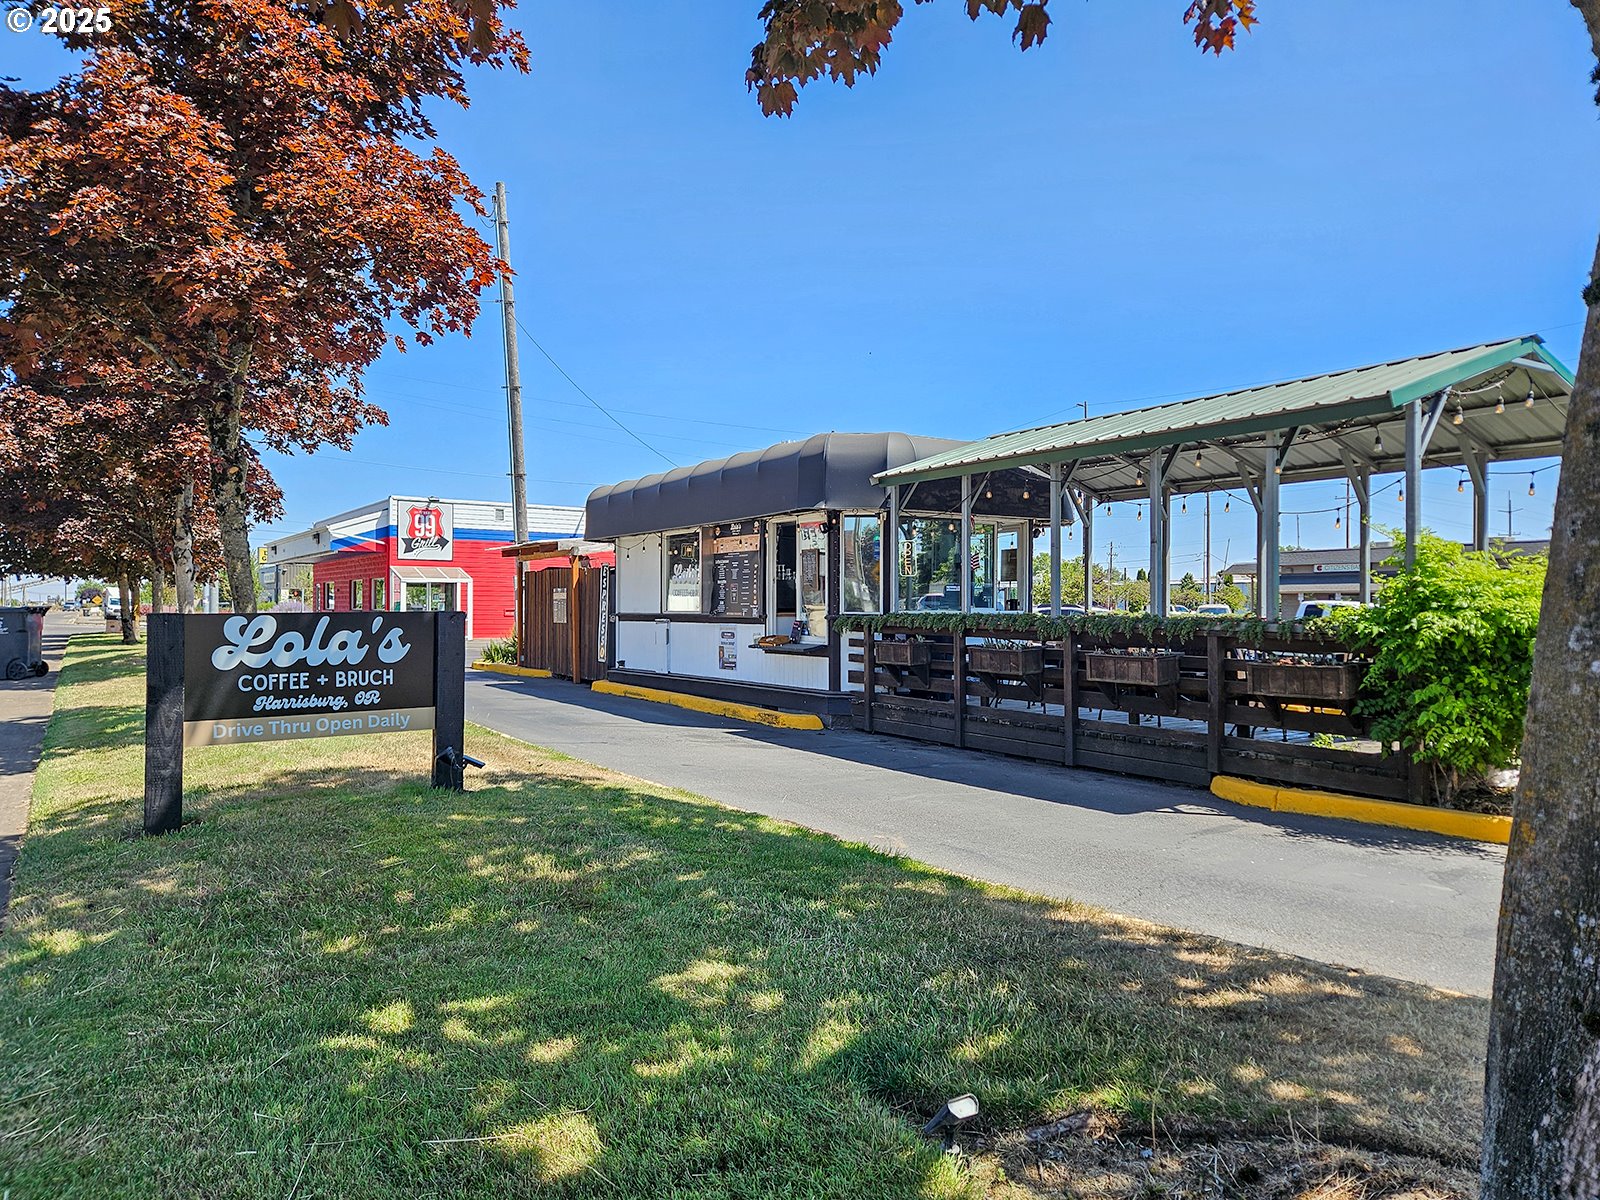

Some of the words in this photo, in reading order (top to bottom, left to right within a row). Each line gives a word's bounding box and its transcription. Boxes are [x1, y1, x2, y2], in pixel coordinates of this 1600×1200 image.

[414, 513, 436, 537] 99
[411, 536, 440, 549] Grill
[903, 541, 913, 575] OPEN
[600, 566, 609, 658] ESPRESSO
[211, 614, 412, 671] Lola's
[238, 672, 310, 692] COFFEE
[316, 674, 329, 686] +
[335, 669, 394, 688] BRUCH
[252, 694, 349, 712] Harrisburg,
[354, 690, 381, 706] OR
[213, 723, 264, 739] Drive
[268, 721, 311, 735] Thru
[315, 717, 363, 735] Open
[368, 712, 411, 730] Daily
